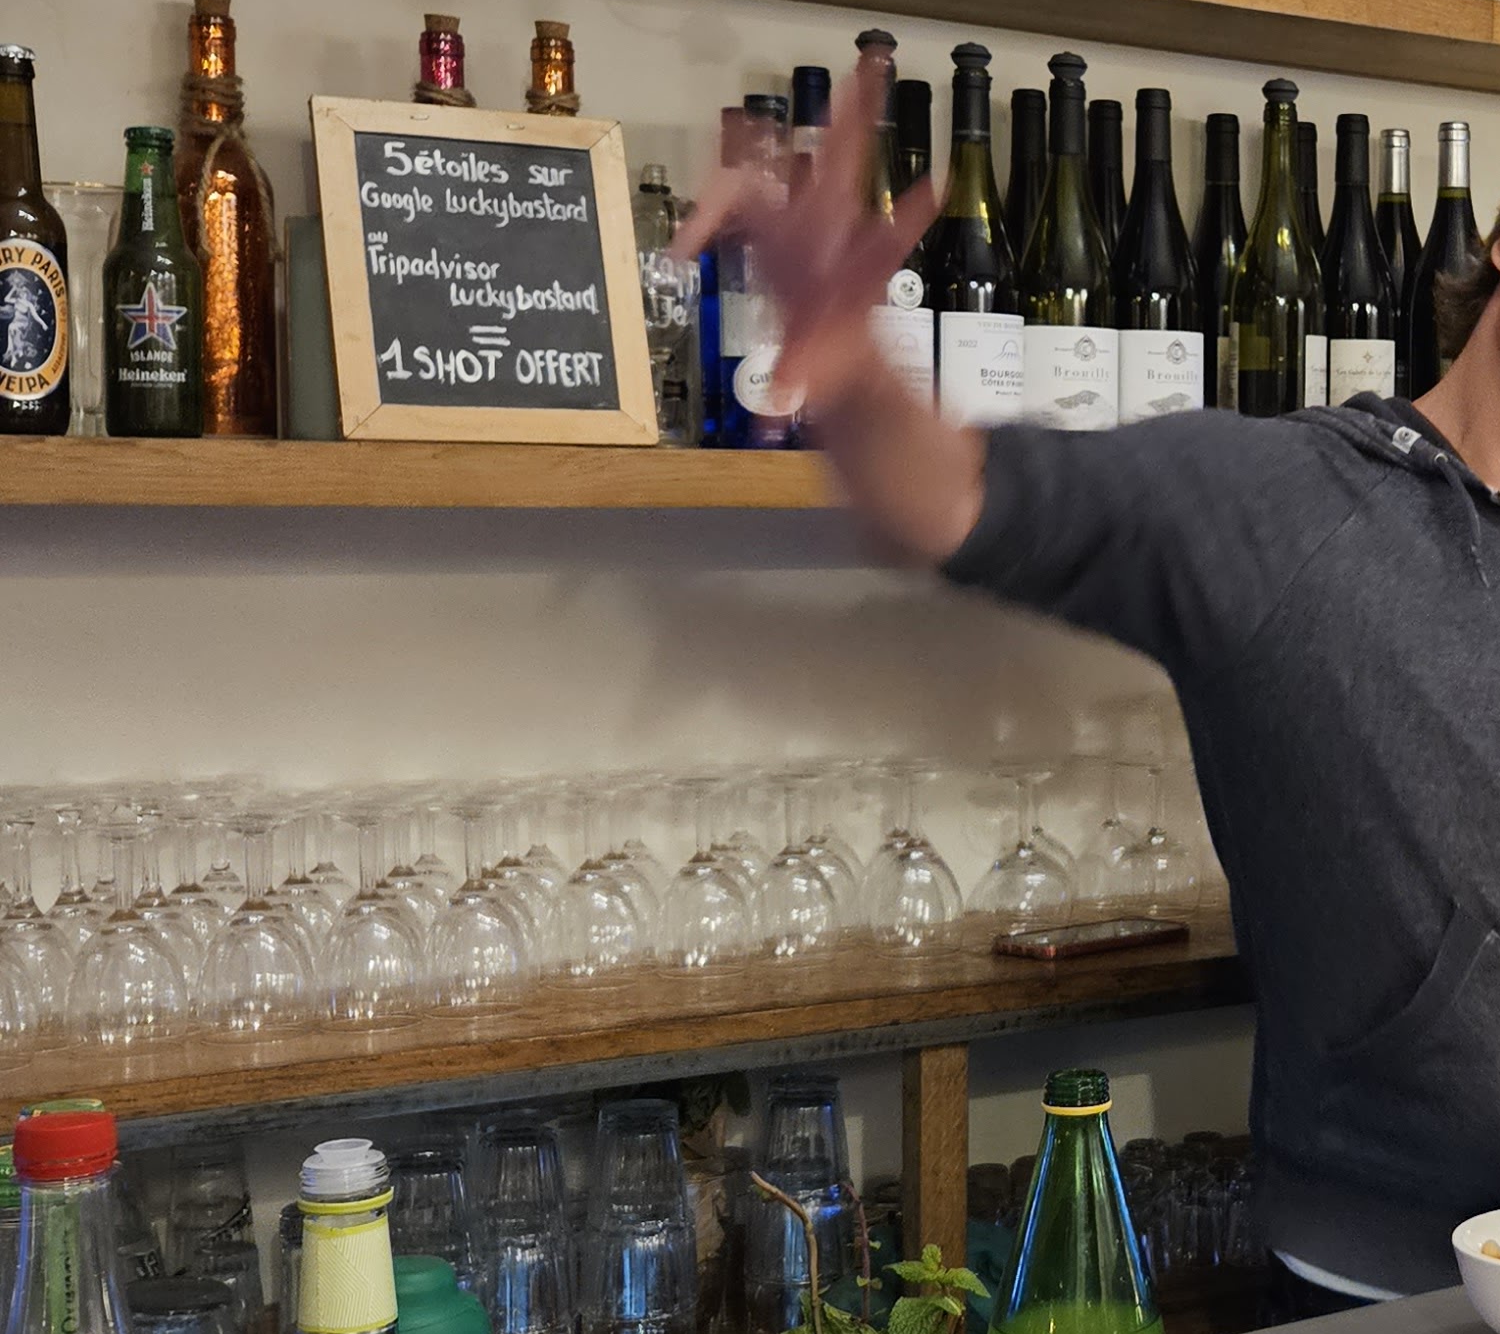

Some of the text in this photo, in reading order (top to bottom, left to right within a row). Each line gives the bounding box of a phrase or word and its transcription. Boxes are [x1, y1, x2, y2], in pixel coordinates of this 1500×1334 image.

[528, 162, 574, 186] sur
[361, 182, 433, 223] Google
[0, 246, 65, 298] RY PARIS
[366, 244, 500, 285] Tripadvisor
[130, 349, 174, 364] ISLANDE
[957, 339, 978, 349] 2022
[515, 349, 603, 387] OFFERT
